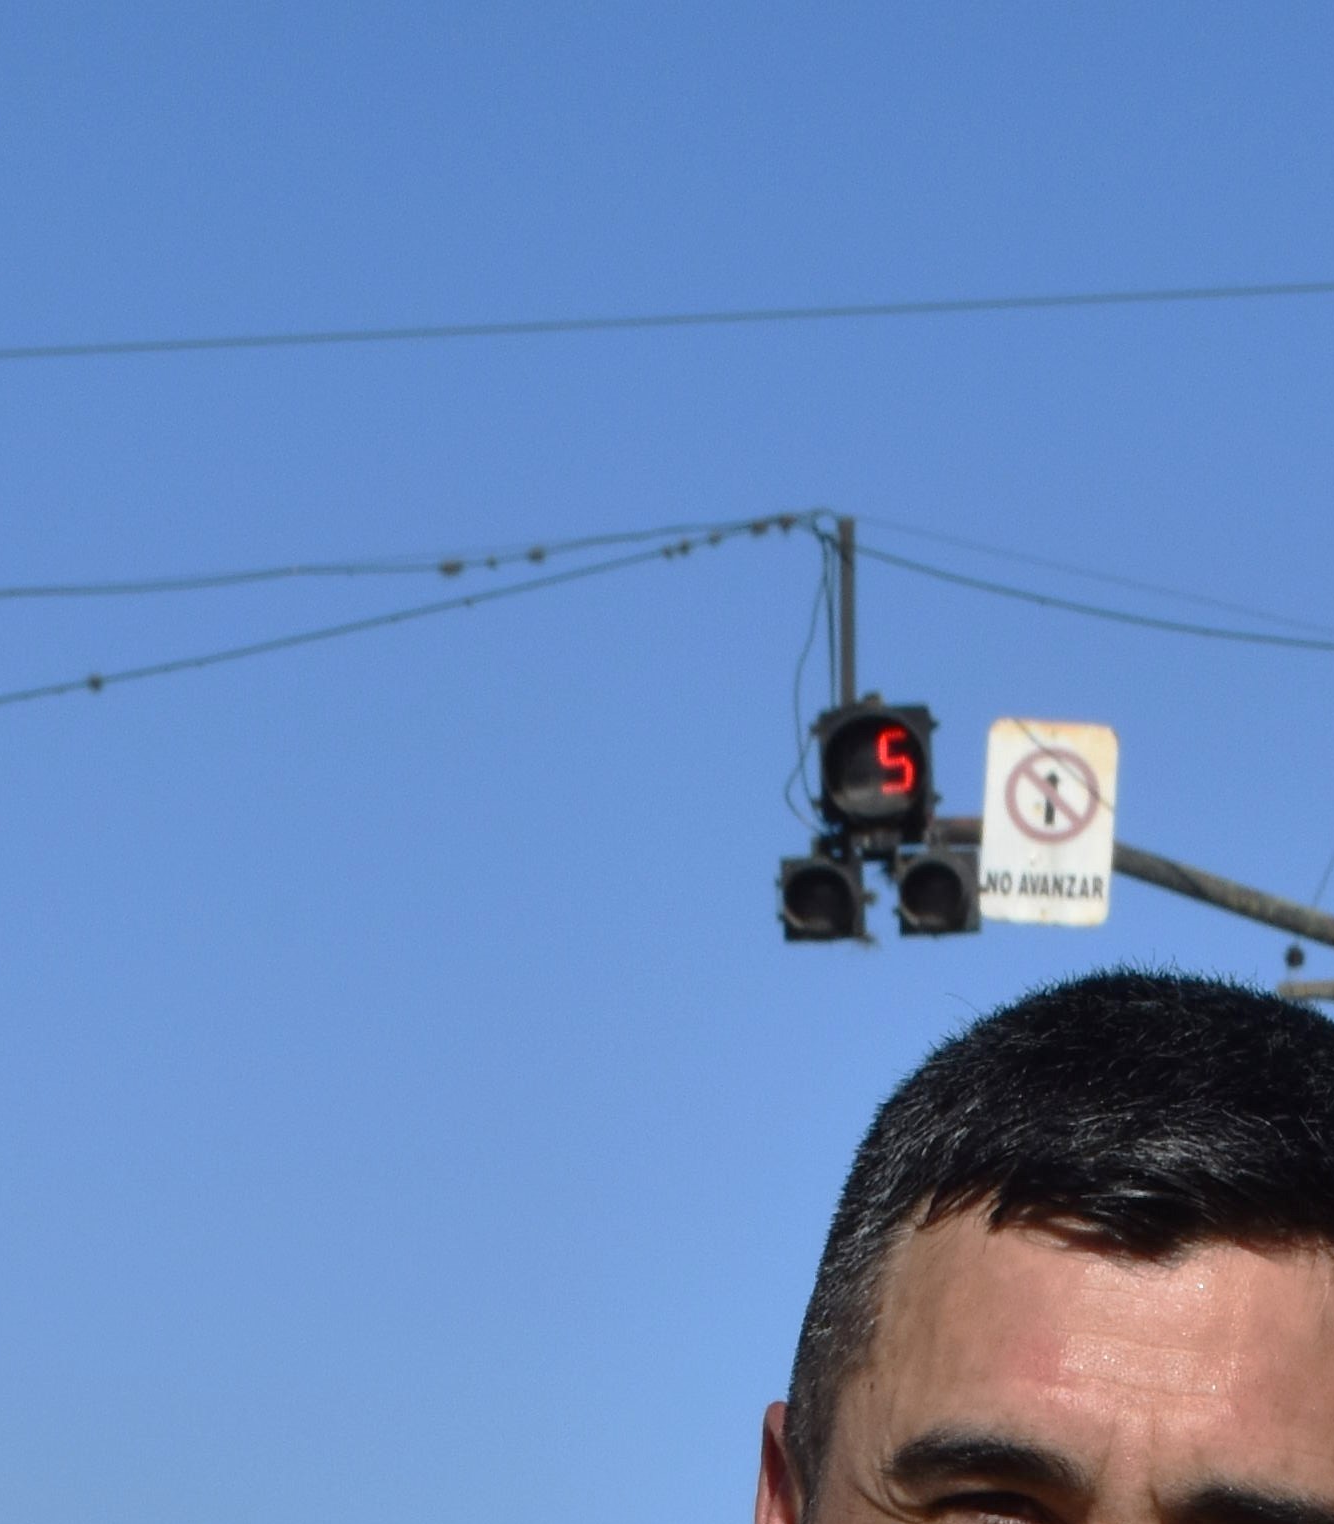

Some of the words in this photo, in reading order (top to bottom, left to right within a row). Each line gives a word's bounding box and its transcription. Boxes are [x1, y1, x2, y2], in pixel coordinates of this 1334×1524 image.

[876, 725, 915, 795] 5
[985, 873, 1013, 895] NO
[1019, 872, 1104, 900] AVANZAR
